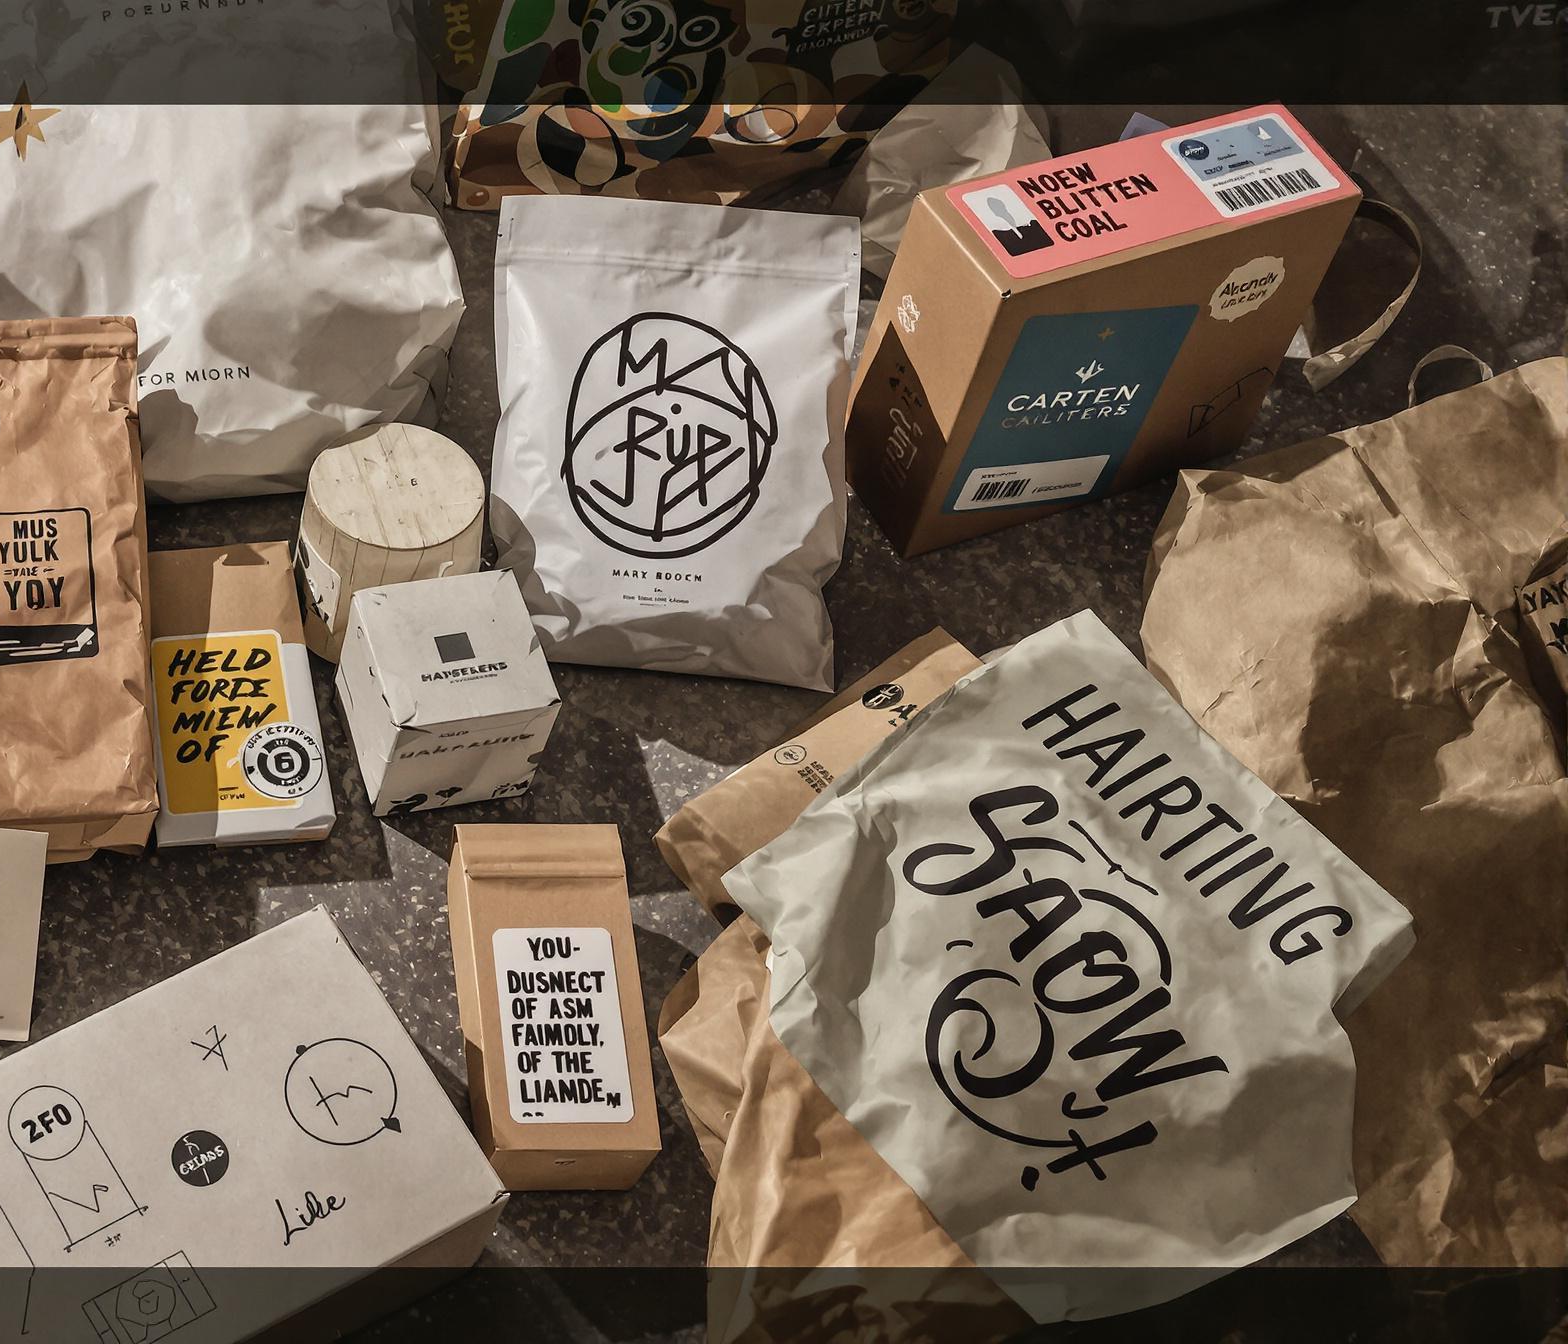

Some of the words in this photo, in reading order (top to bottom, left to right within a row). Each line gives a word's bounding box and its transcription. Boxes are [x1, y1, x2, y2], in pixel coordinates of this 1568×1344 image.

[1017, 162, 1097, 199] NOEW
[1036, 173, 1159, 220] BLITTEN
[1055, 211, 1128, 243] COAL
[138, 372, 176, 387] FOR
[185, 366, 250, 382] MIORN
[1007, 383, 1141, 412] CARTEN
[12, 517, 58, 540] MUS
[168, 648, 272, 678] HELD
[176, 734, 230, 764] OF
[506, 970, 606, 994] DUSNECT
[511, 998, 538, 1019] OF
[549, 998, 594, 1019] ASM
[512, 1023, 605, 1048] FAIMOLY,
[517, 1051, 542, 1074] OF
[551, 1051, 594, 1074] THE
